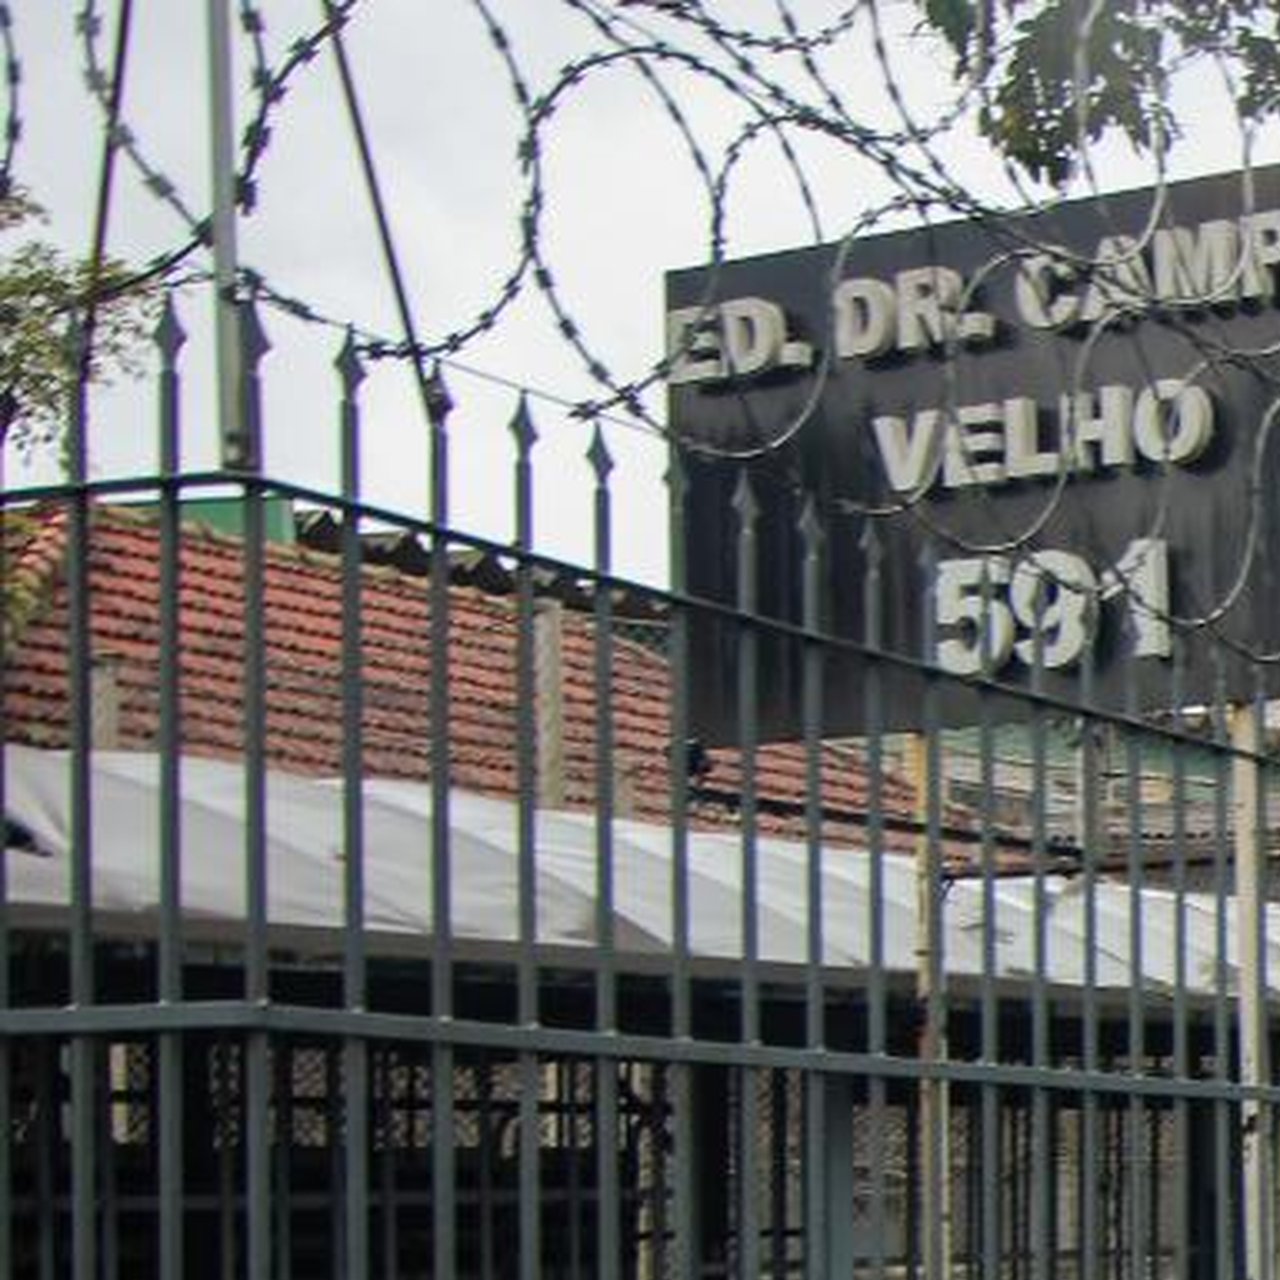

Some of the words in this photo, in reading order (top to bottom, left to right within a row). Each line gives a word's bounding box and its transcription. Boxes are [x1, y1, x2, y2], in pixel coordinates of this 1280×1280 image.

[667, 296, 814, 385] ED.
[834, 266, 998, 361] DR.
[872, 378, 1218, 494] VELHO
[935, 537, 1174, 675] 591
